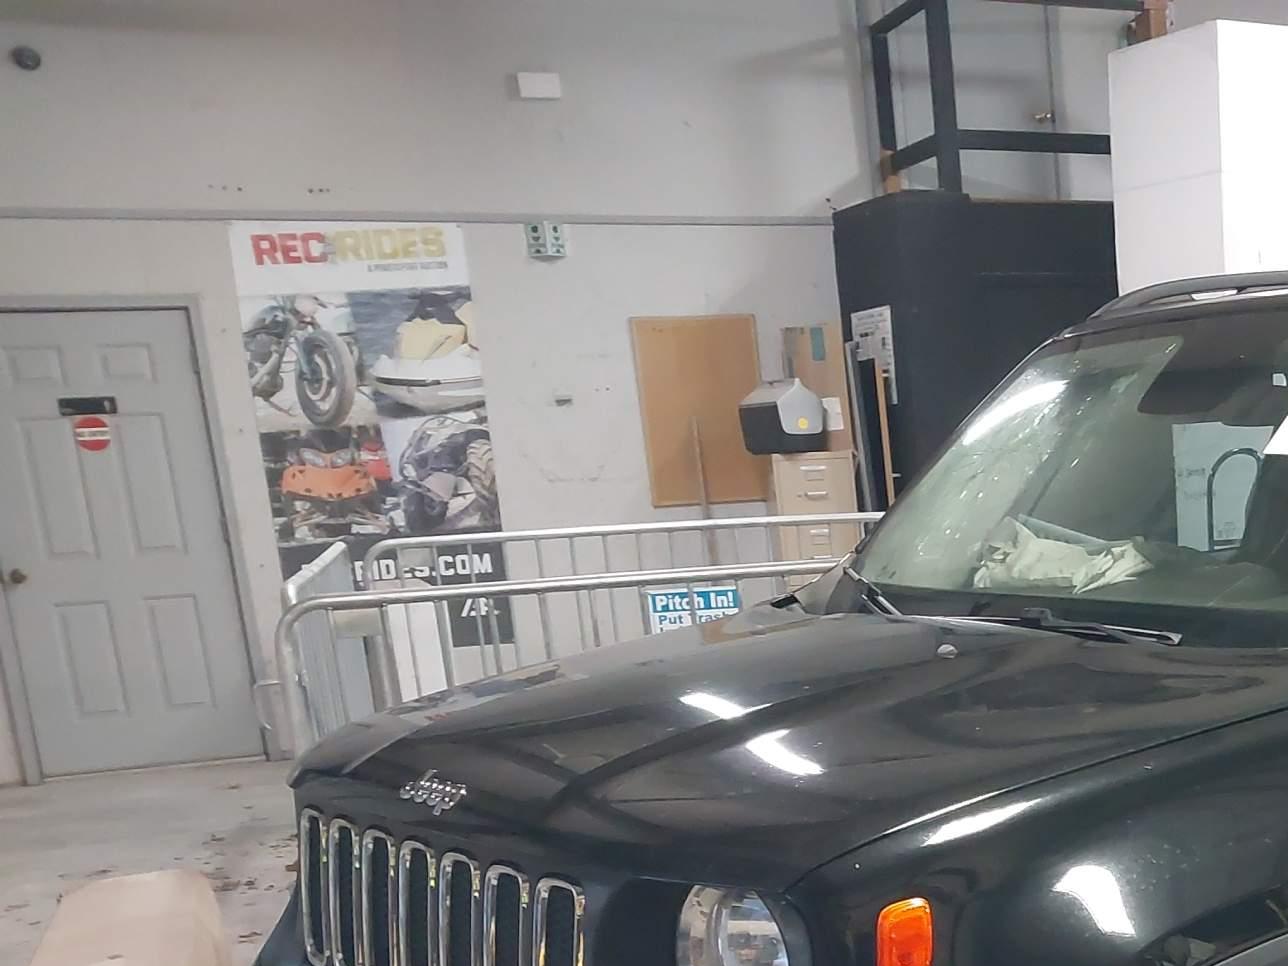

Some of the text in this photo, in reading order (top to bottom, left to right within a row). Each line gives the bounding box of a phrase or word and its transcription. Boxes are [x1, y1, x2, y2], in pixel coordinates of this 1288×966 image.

[250, 227, 446, 266] REC RIDES
[654, 591, 734, 611] Pitch In!
[658, 614, 684, 625] Put
[400, 768, 467, 815] Jeep
